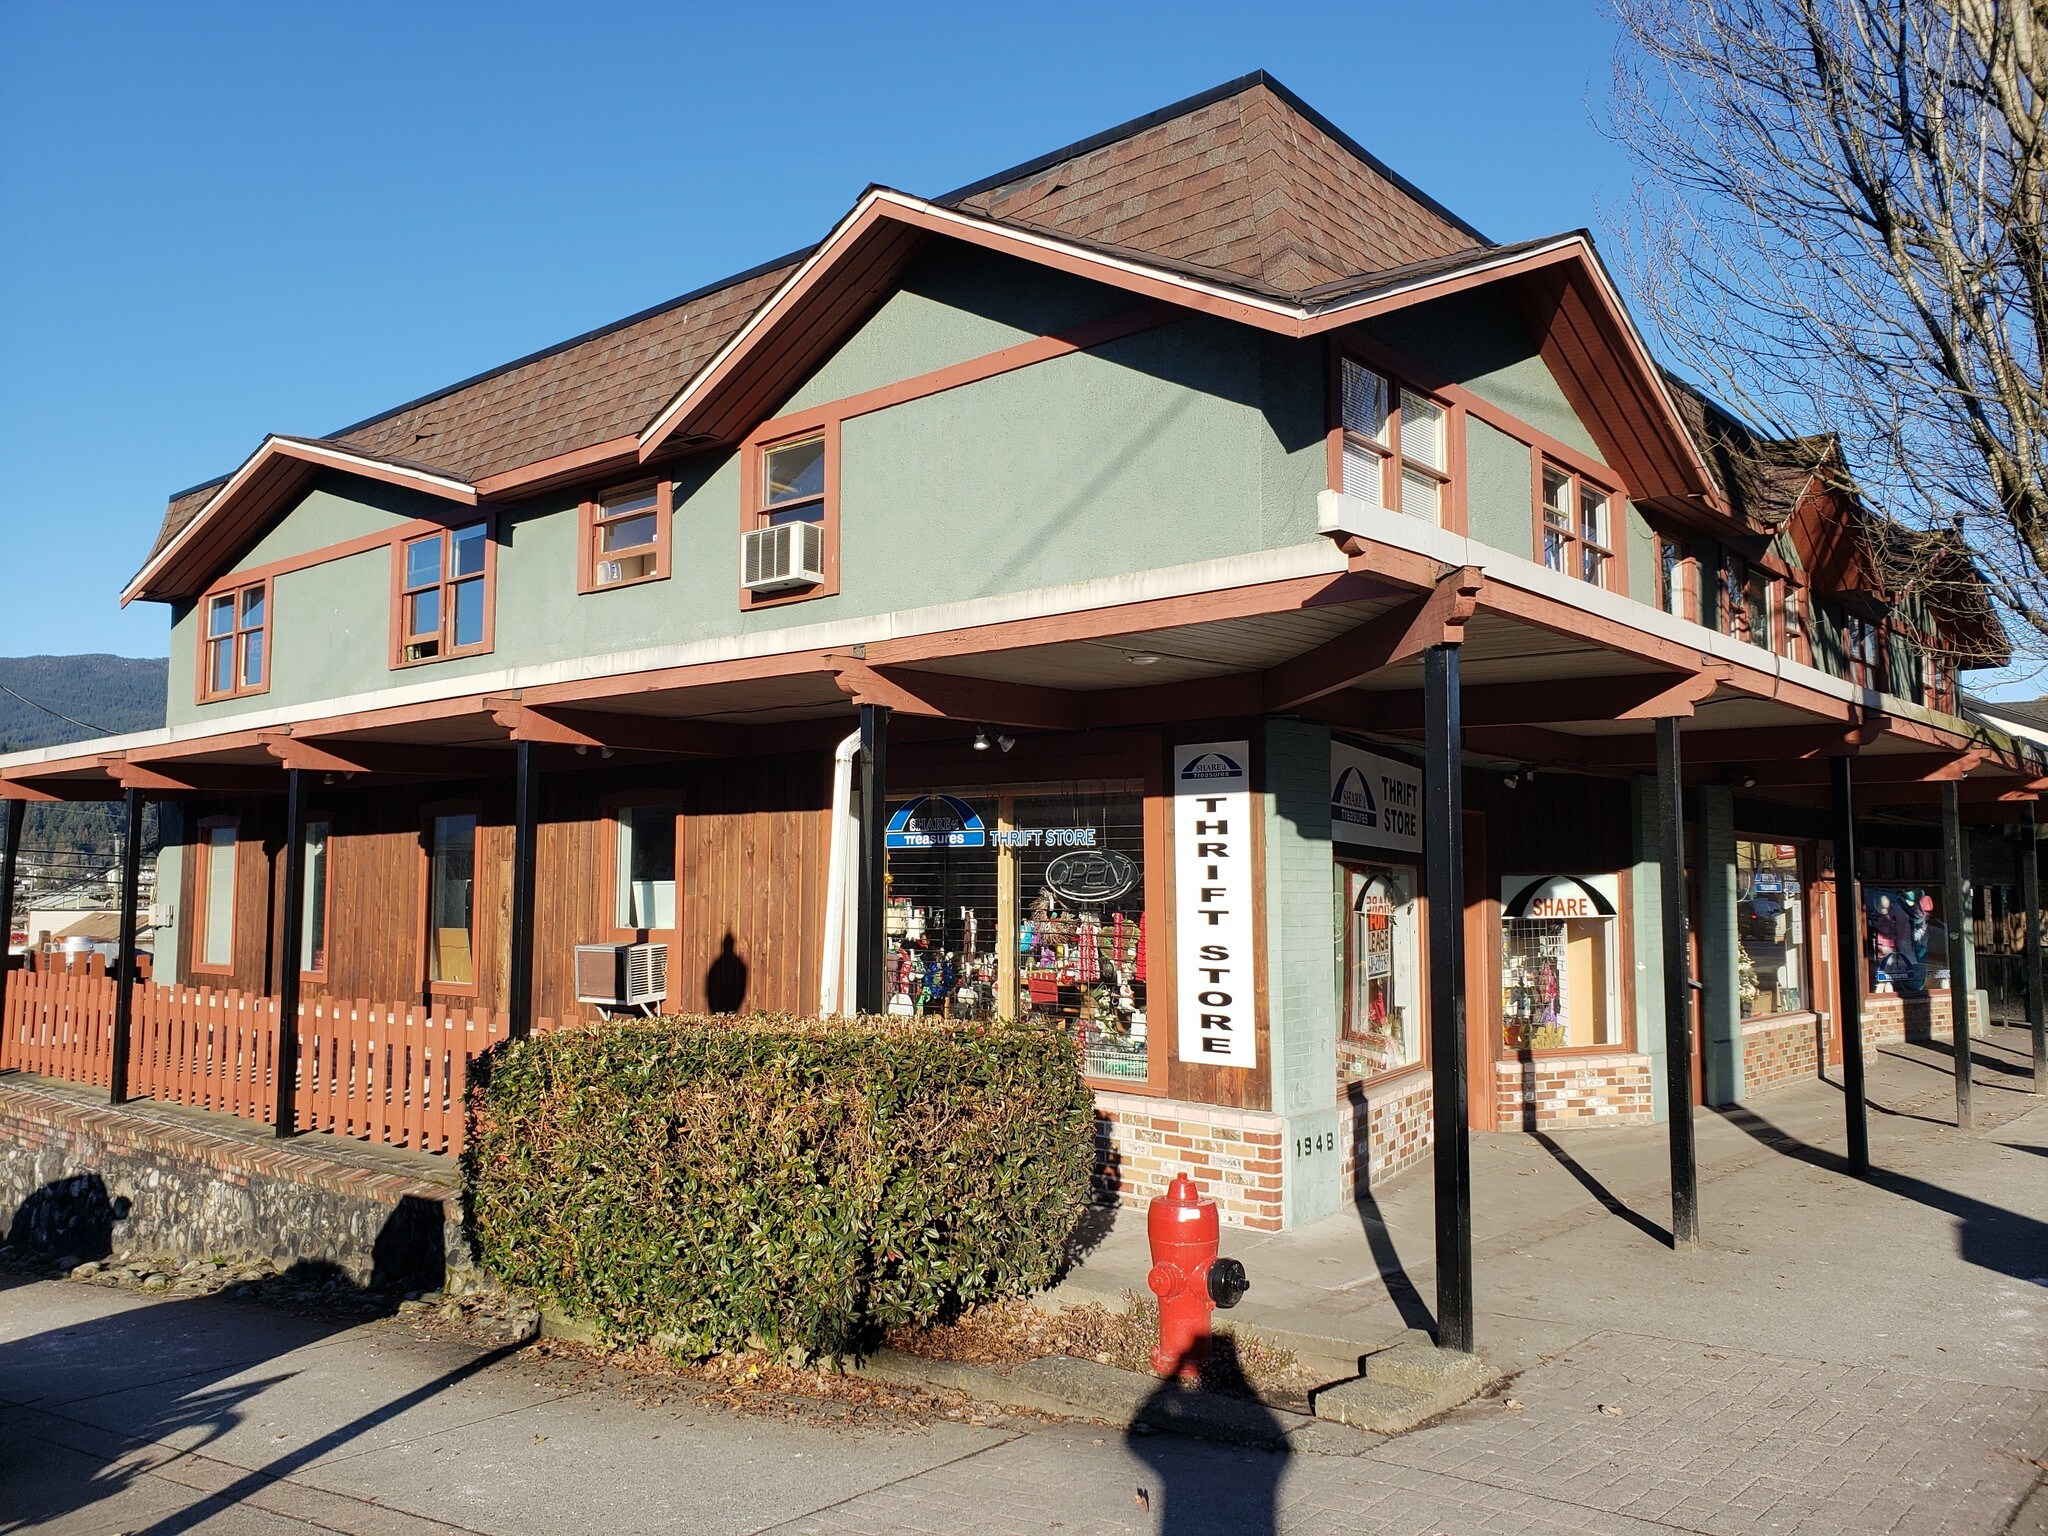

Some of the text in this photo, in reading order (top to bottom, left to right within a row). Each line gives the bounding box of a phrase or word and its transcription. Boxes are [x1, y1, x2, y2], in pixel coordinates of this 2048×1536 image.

[1381, 775, 1418, 808] THRIFT
[1341, 808, 1369, 825] Treasures
[1384, 807, 1417, 837] STORE
[904, 833, 965, 846] Treasures
[990, 828, 1096, 848] THRIFT STORE
[1049, 860, 1128, 886] OPEN
[1532, 897, 1588, 917] SHARE
[1196, 797, 1234, 1055] THRIFT STORE
[1368, 930, 1389, 953] LEASE
[1296, 1132, 1334, 1158] 1948
